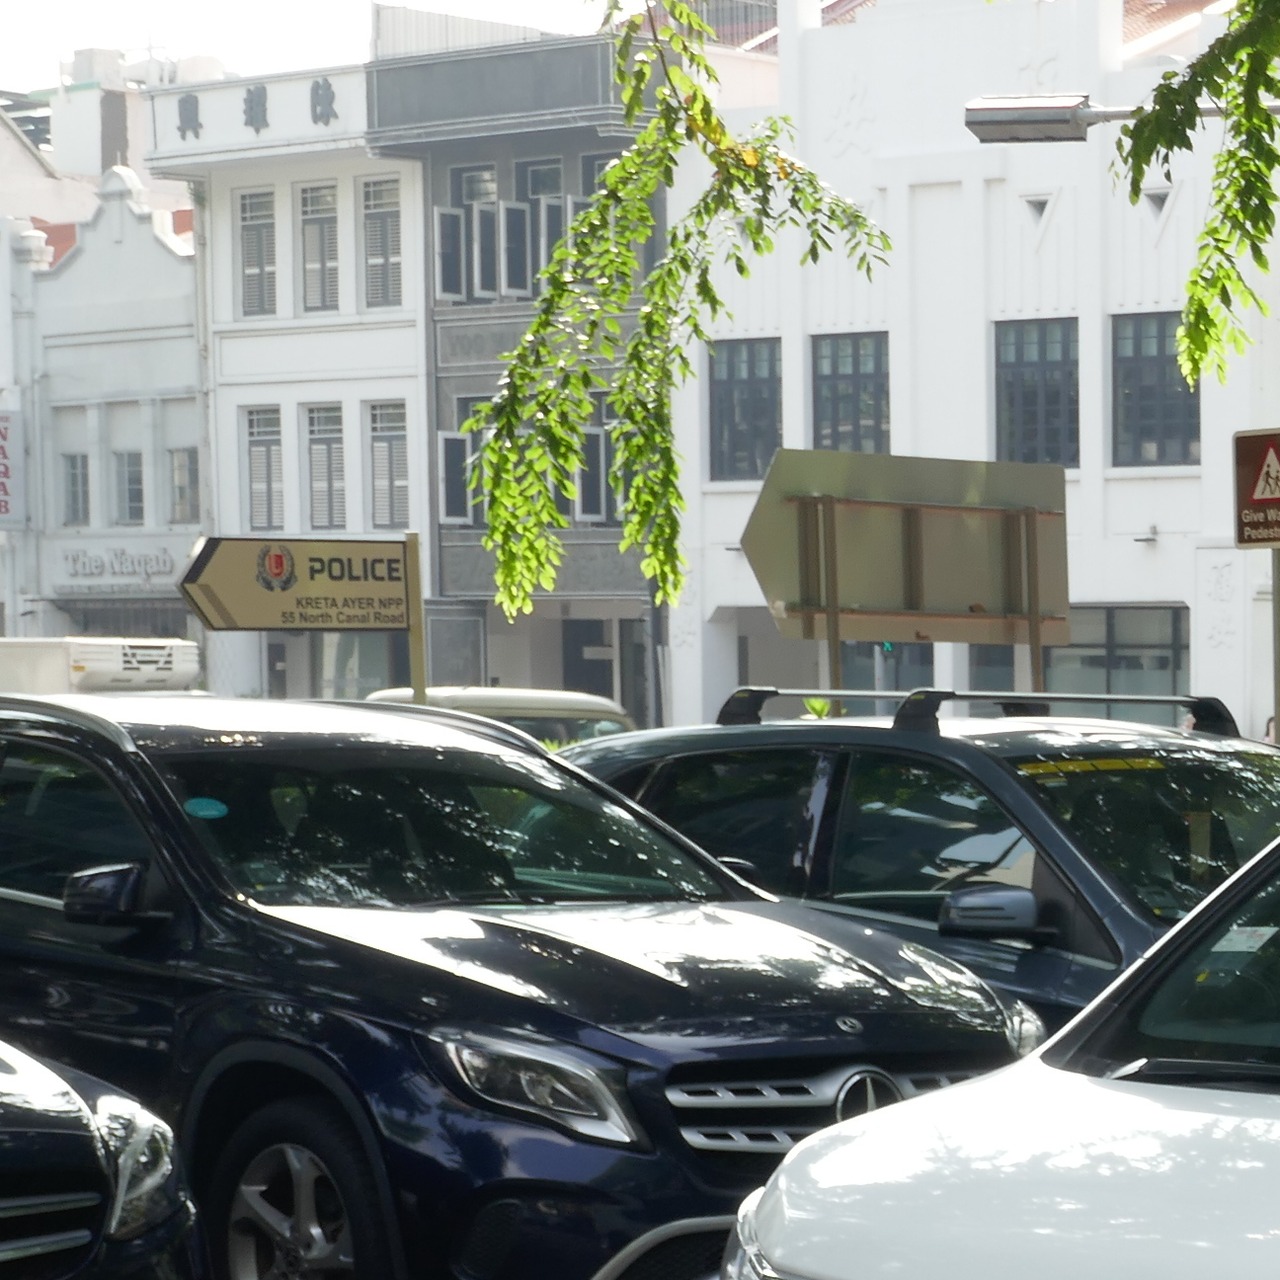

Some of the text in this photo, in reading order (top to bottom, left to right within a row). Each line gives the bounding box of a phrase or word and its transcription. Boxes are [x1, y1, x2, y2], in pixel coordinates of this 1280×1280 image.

[1241, 509, 1265, 523] Give
[63, 549, 105, 577] The
[308, 557, 403, 582] POLICE
[296, 597, 404, 610] KRETA AYER NPP
[281, 611, 405, 625] 55 North Canal Road
